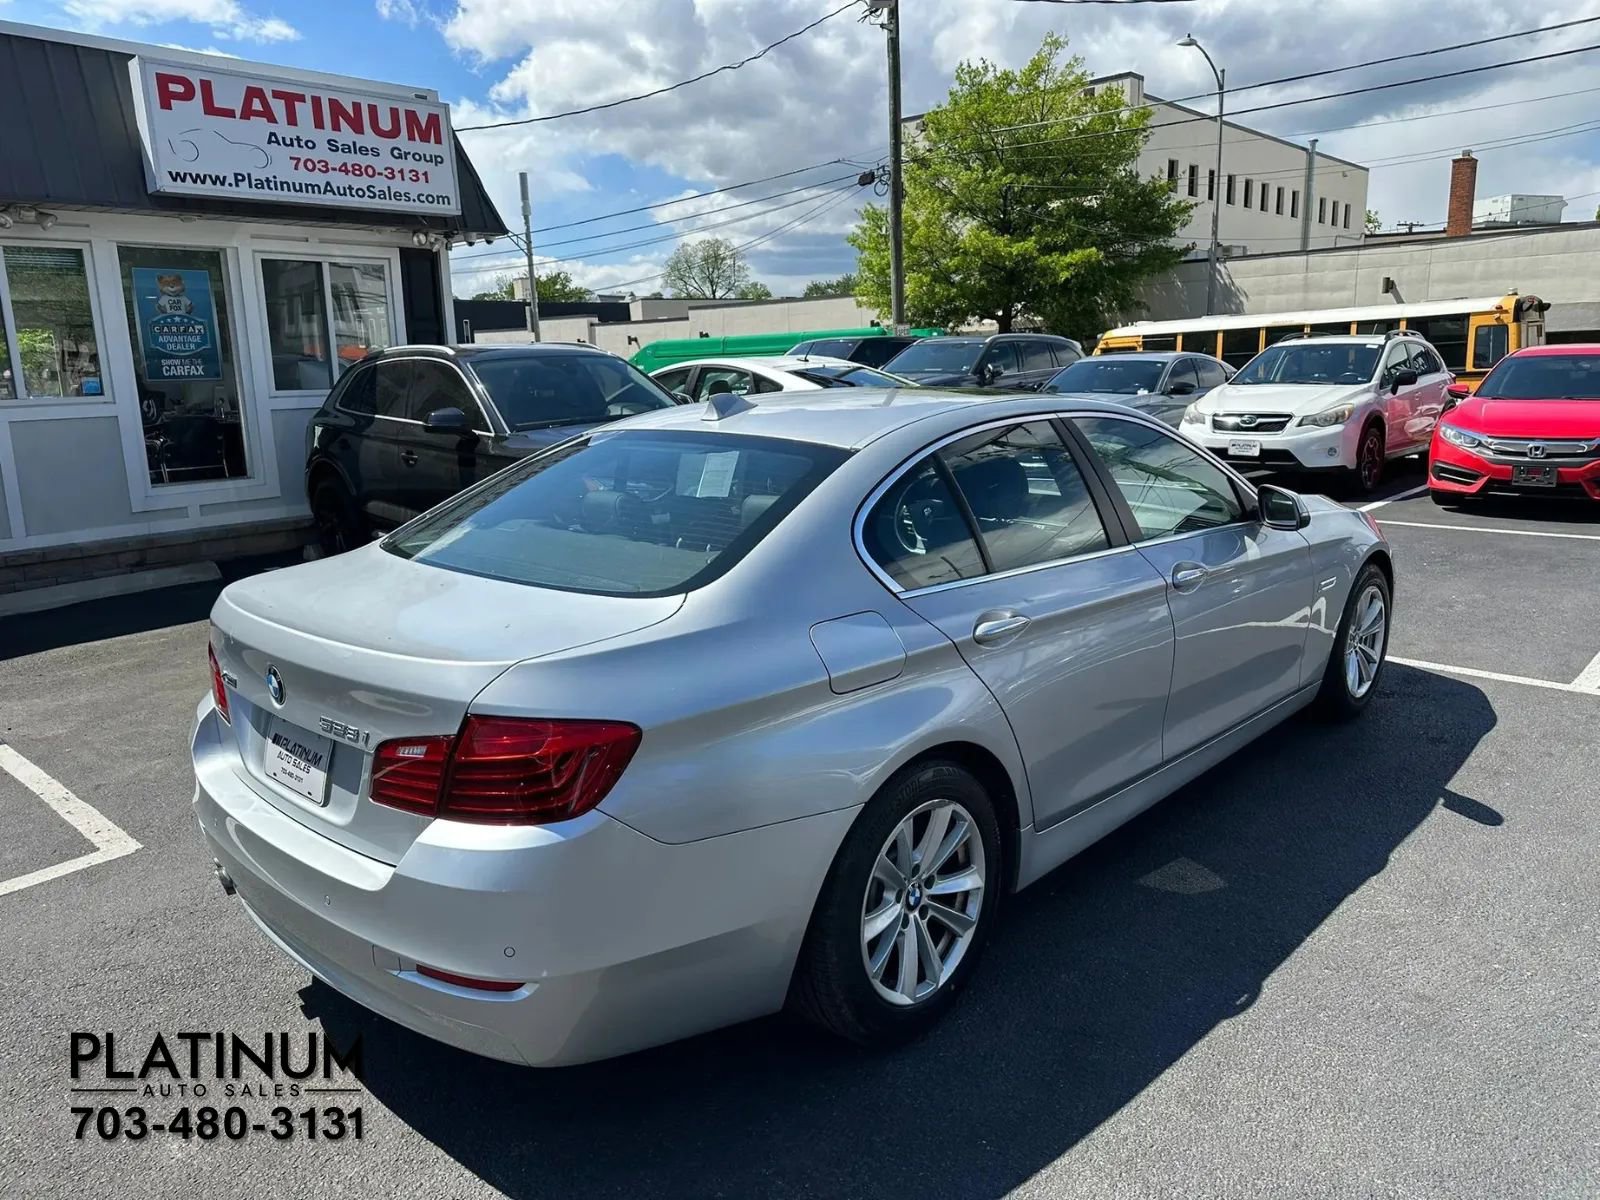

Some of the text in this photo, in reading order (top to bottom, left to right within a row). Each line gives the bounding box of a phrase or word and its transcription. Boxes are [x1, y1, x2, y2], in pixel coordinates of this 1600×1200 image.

[155, 72, 443, 145] PLATINUM
[267, 131, 444, 167] Auto Sales Group
[289, 156, 430, 184] 703-480-3131
[168, 170, 451, 206] www.PlatinumAutoSales.com
[154, 325, 204, 334] CARFAX
[158, 335, 202, 343] ADVANTAGE
[161, 358, 181, 366] SHOW
[162, 365, 205, 376] CARFAX
[277, 750, 311, 775] AUTO SALES
[280, 736, 323, 768] PLATINUM
